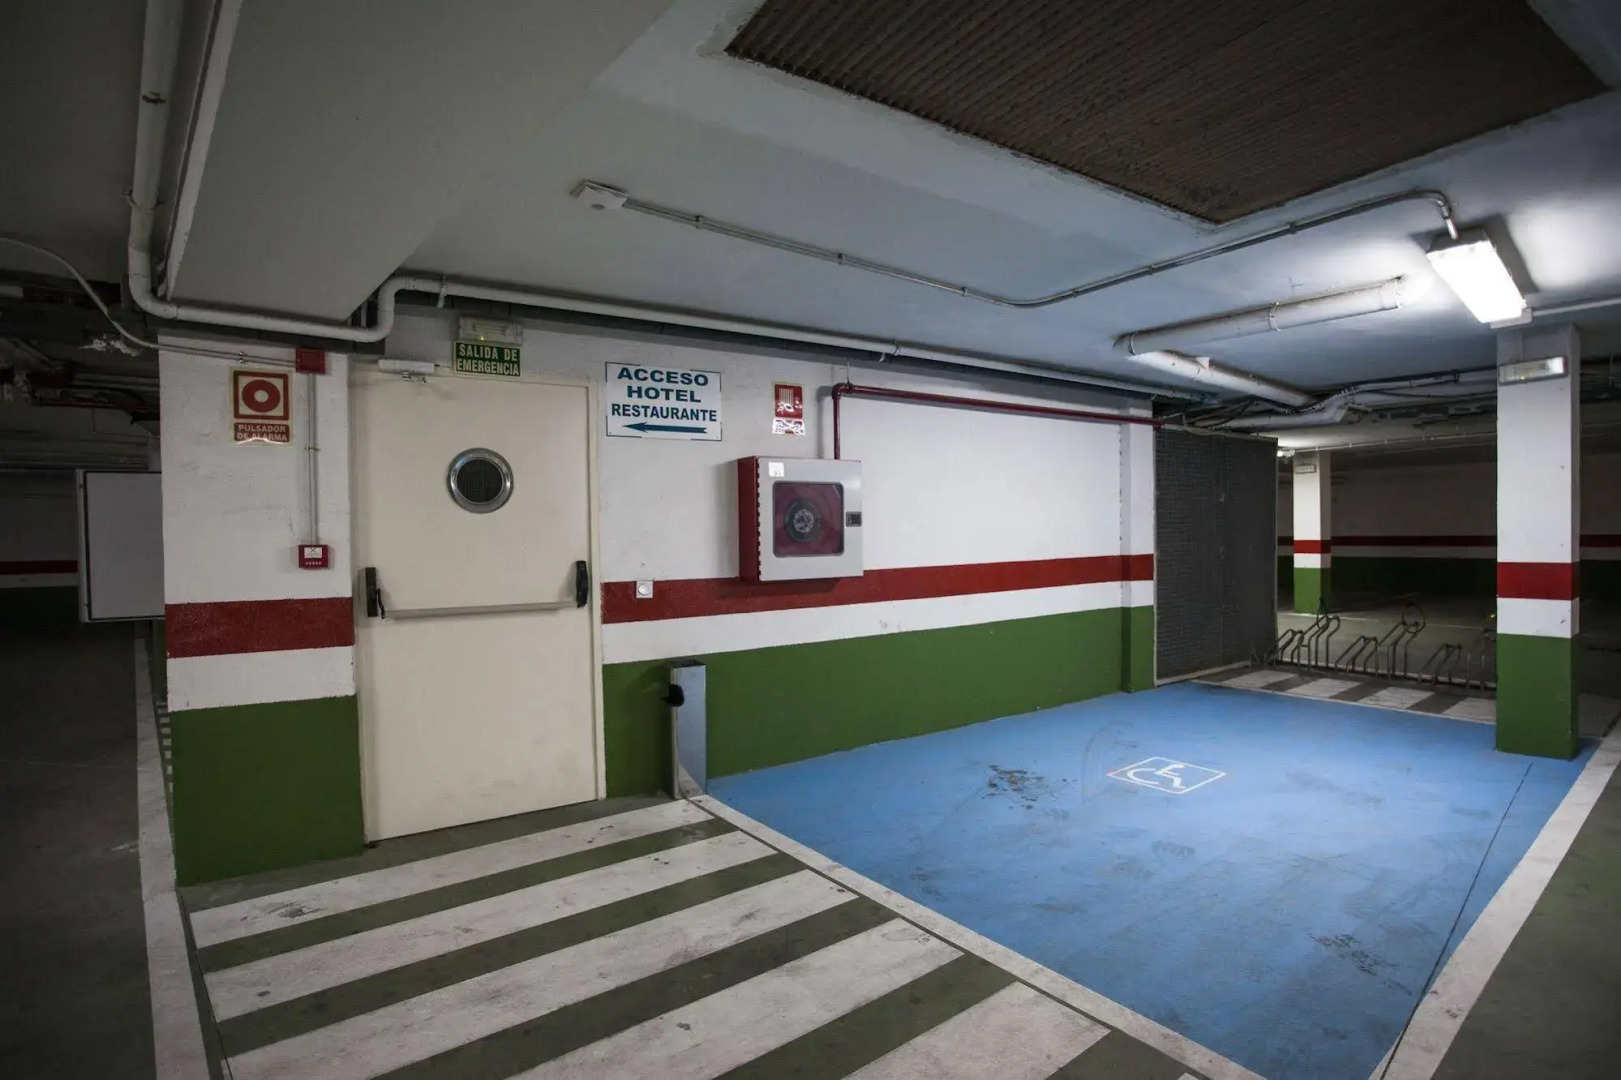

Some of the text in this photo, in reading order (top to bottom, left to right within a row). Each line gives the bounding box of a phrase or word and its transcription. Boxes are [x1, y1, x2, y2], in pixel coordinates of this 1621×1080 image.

[459, 344, 518, 361] SALIDA DE
[457, 358, 519, 376] EMERGENCIA
[617, 367, 709, 386] ACCESO
[627, 385, 702, 403] HOTEL
[611, 403, 717, 422] RESTAURANTE
[236, 432, 288, 441] DE ALARMA
[238, 424, 286, 433] PULSADOR
